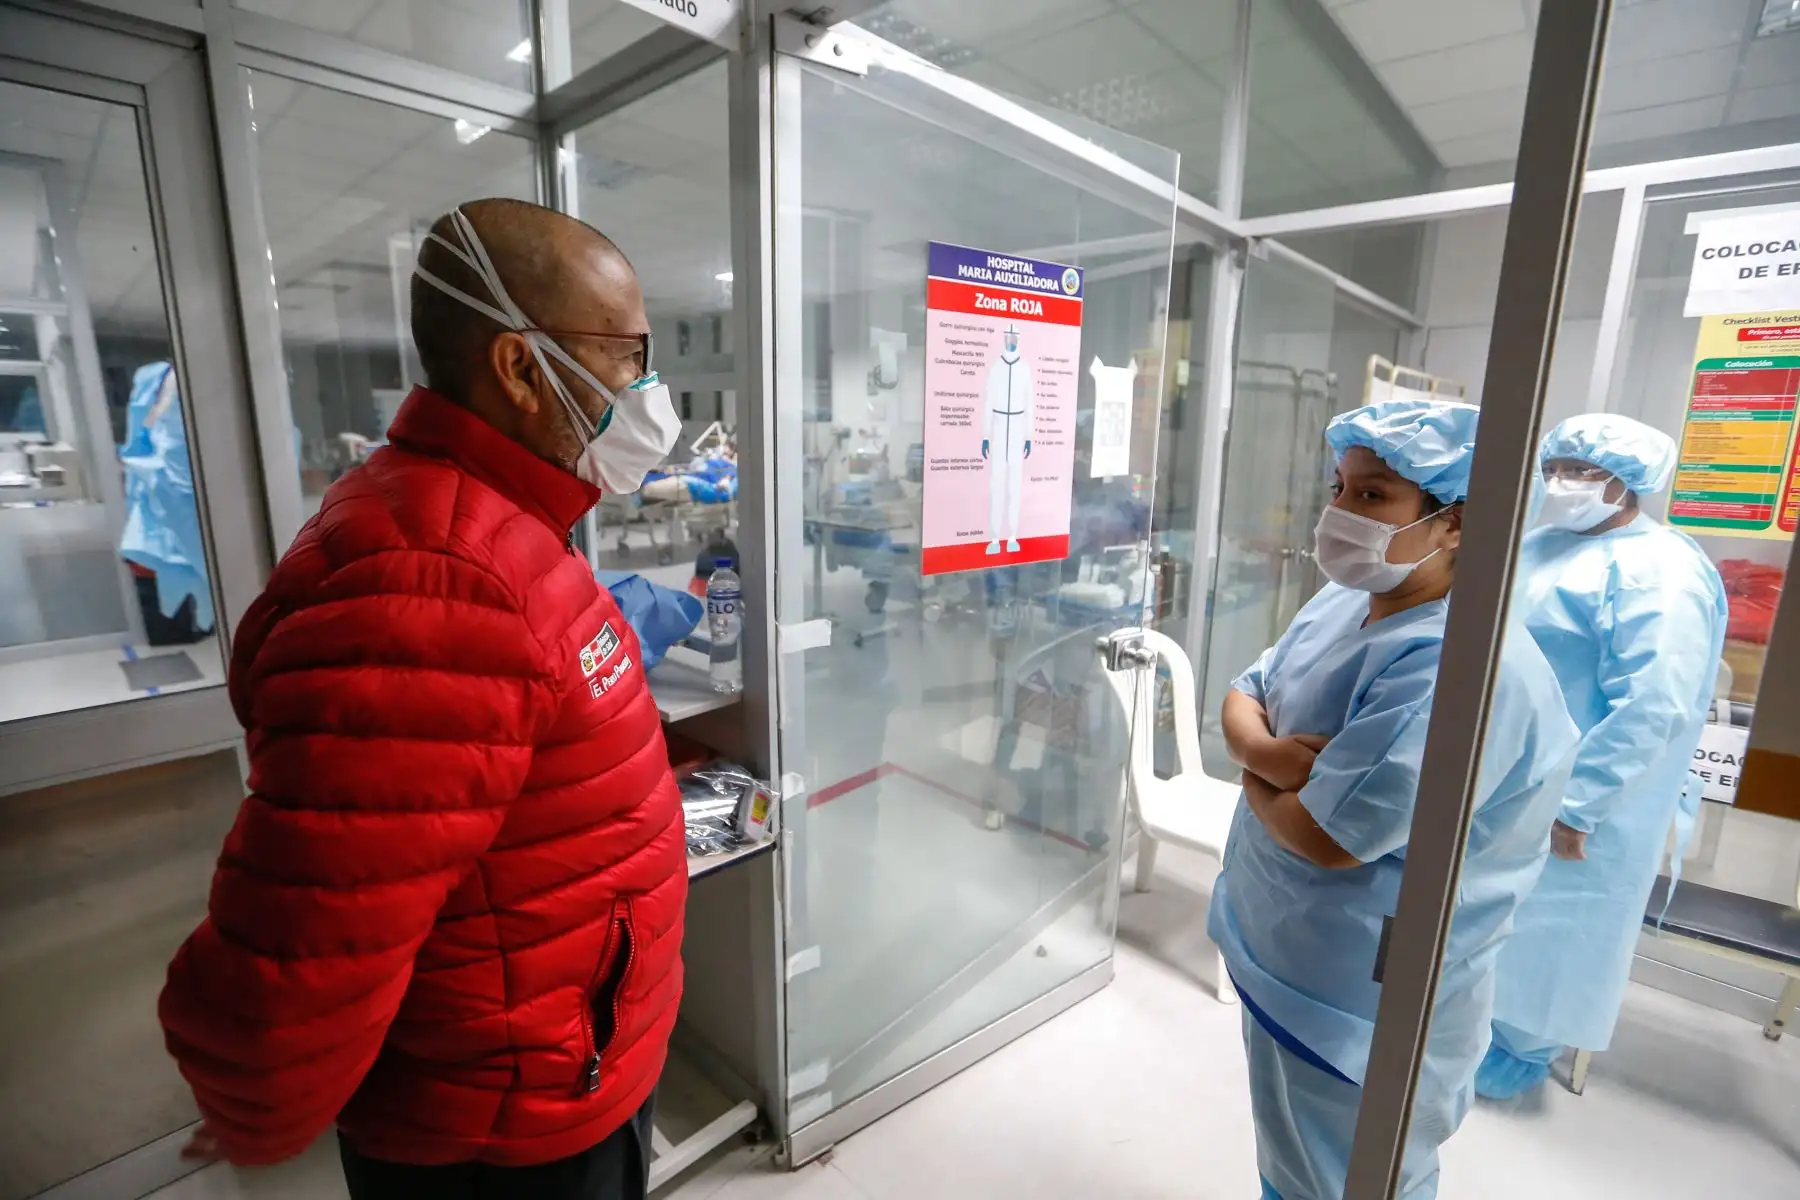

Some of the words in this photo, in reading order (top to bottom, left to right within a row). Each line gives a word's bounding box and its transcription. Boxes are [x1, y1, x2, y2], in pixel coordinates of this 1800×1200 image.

[1701, 239, 1800, 260] COLOCA
[987, 256, 1035, 275] HOSPITAL
[1738, 265, 1769, 279] DE
[958, 264, 992, 281] MARIA
[994, 271, 1059, 291] AUXILIADORA
[975, 293, 1007, 311] Zona
[1010, 297, 1043, 316] ROJA
[1723, 316, 1771, 325] Checklist
[1688, 769, 1712, 783] E
